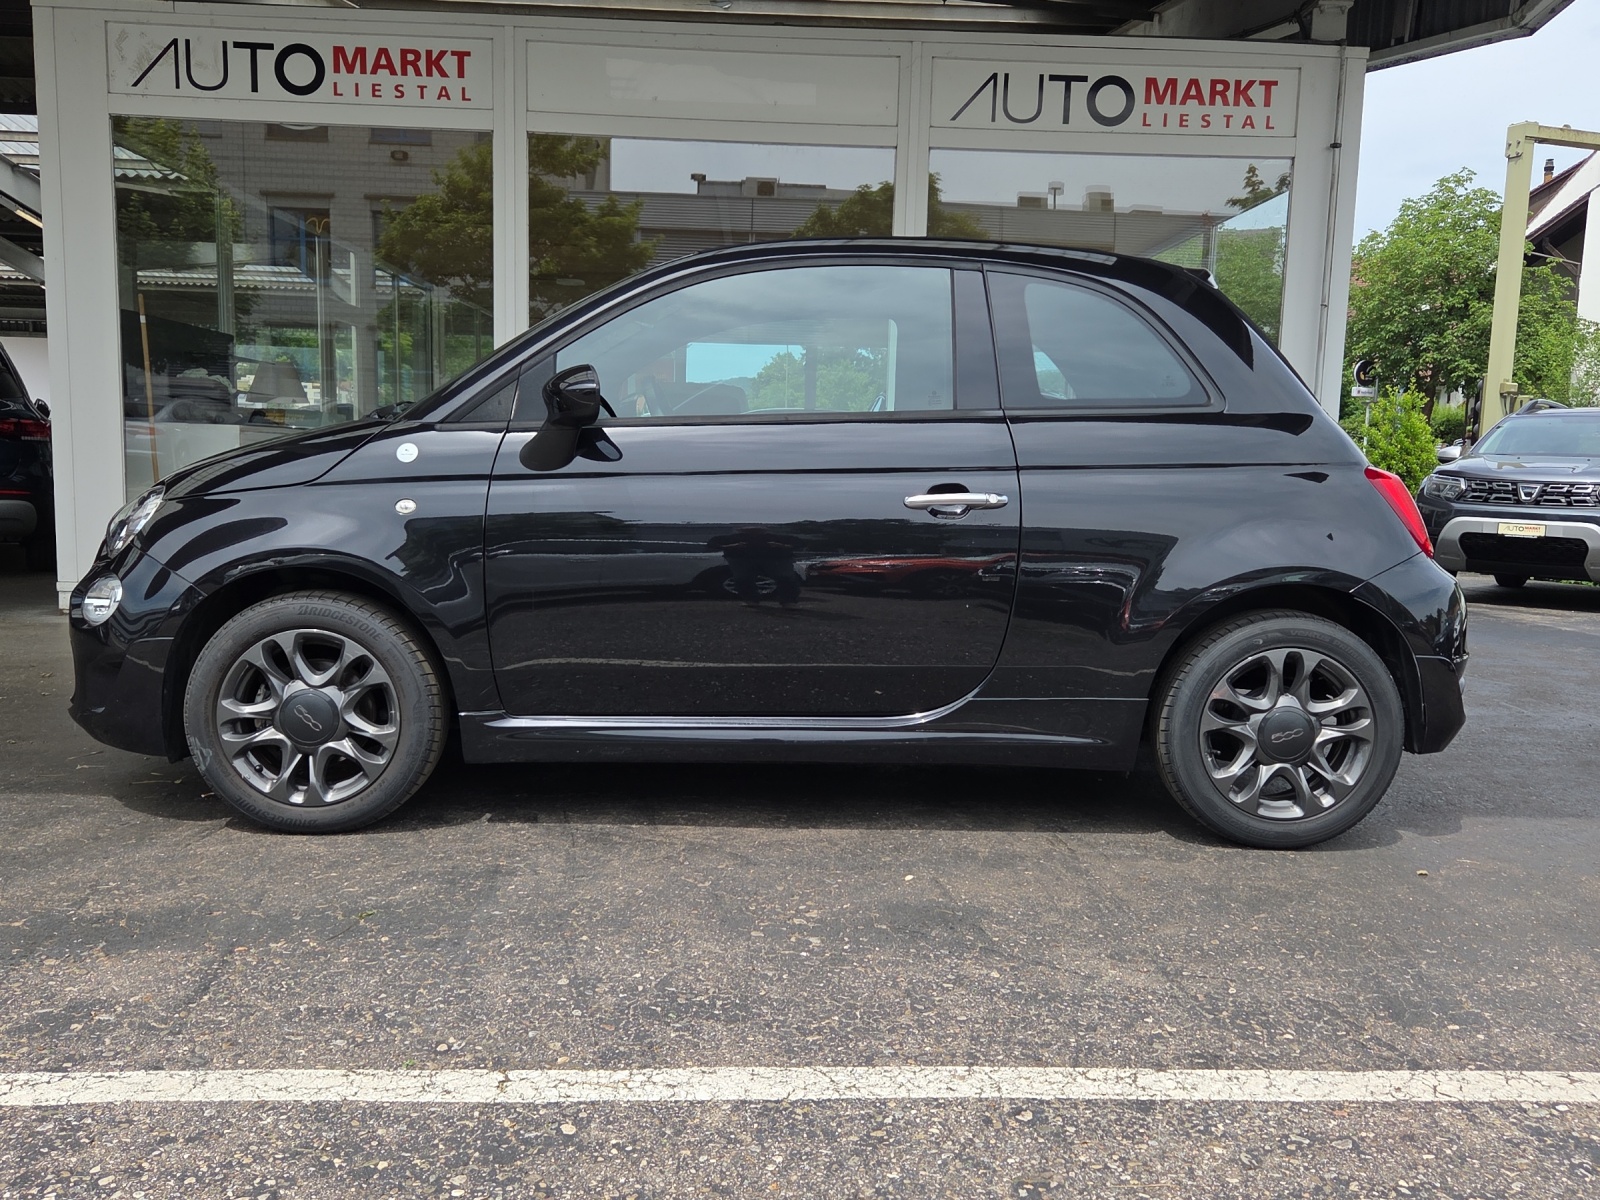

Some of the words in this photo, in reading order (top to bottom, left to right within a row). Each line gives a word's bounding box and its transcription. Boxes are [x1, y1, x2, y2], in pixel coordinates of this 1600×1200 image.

[333, 81, 472, 102] LIESTAL
[1142, 112, 1276, 130] LIESTAL
[297, 604, 384, 641] BRIDGESTONE
